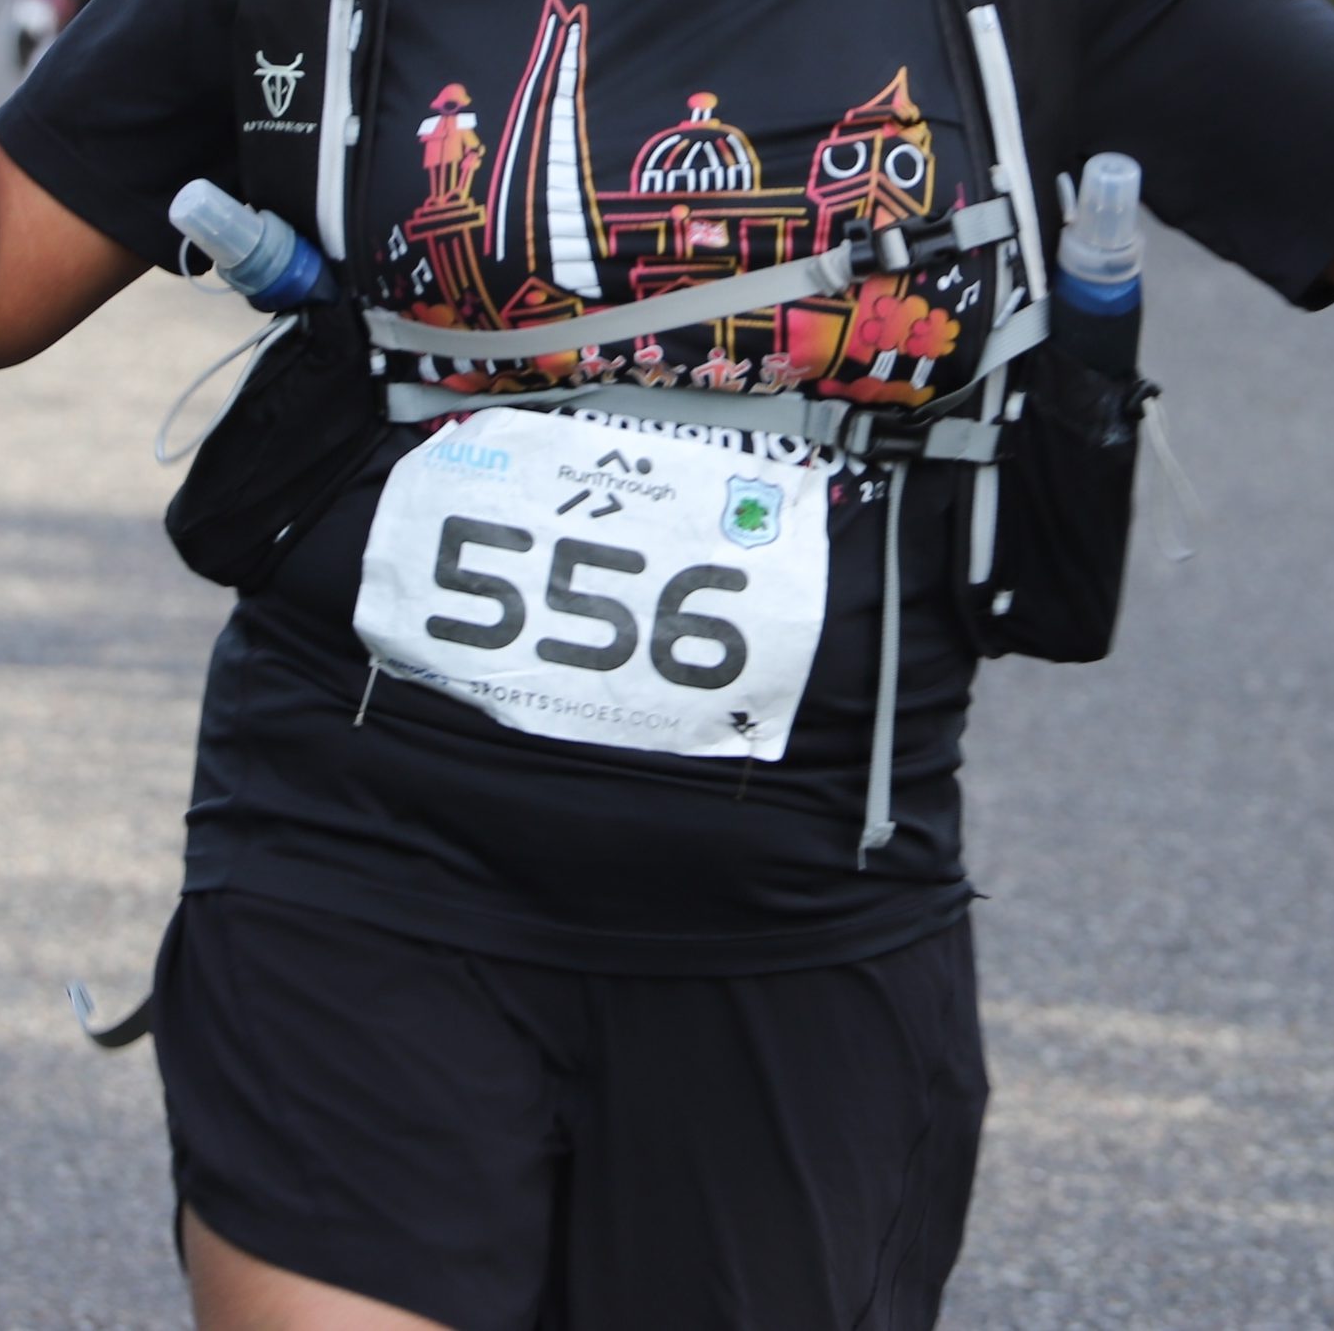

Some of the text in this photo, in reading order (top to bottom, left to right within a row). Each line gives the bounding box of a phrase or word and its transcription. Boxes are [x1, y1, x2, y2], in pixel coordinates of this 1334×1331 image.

[557, 464, 677, 502] RunThrough
[425, 514, 750, 691] 556
[469, 679, 680, 733] SPORTSSHOES.COM
